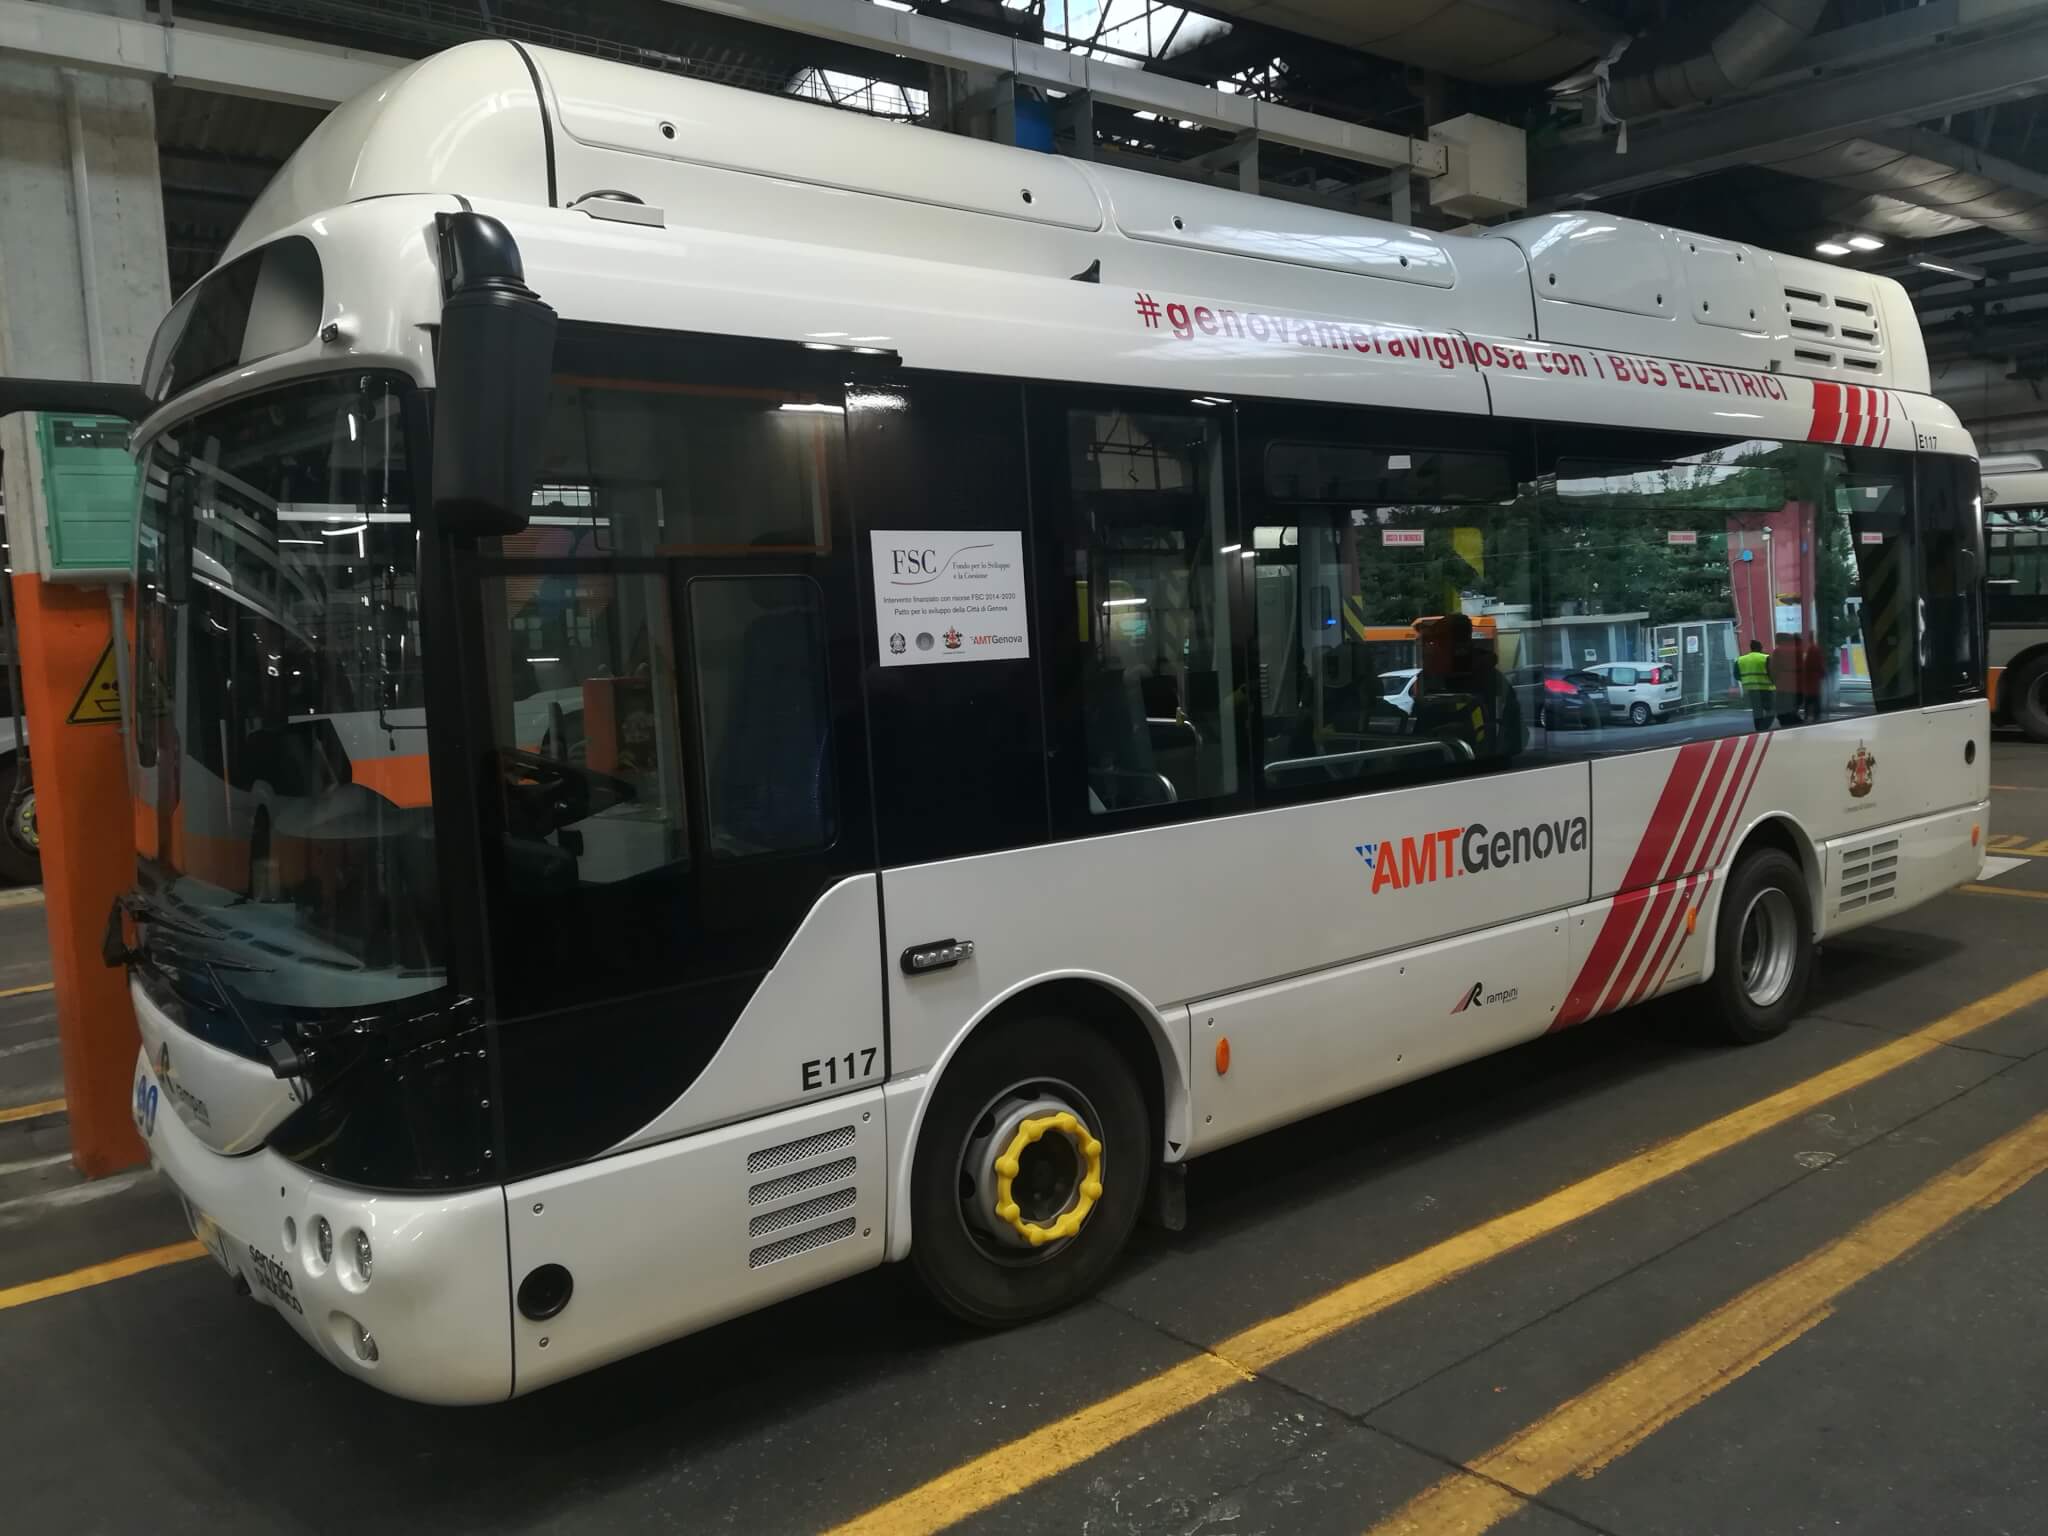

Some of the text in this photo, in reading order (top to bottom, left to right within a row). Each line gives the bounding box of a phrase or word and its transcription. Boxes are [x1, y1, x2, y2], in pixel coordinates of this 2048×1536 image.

[1535, 351, 1588, 377] con
[1588, 351, 1605, 379] i
[1607, 354, 1668, 387] BUS
[1668, 362, 1788, 401] ELETTRICI
[1918, 434, 1937, 450] E117
[891, 549, 937, 575] FSC
[1486, 986, 1519, 1004] rampini
[802, 1047, 877, 1091] E117
